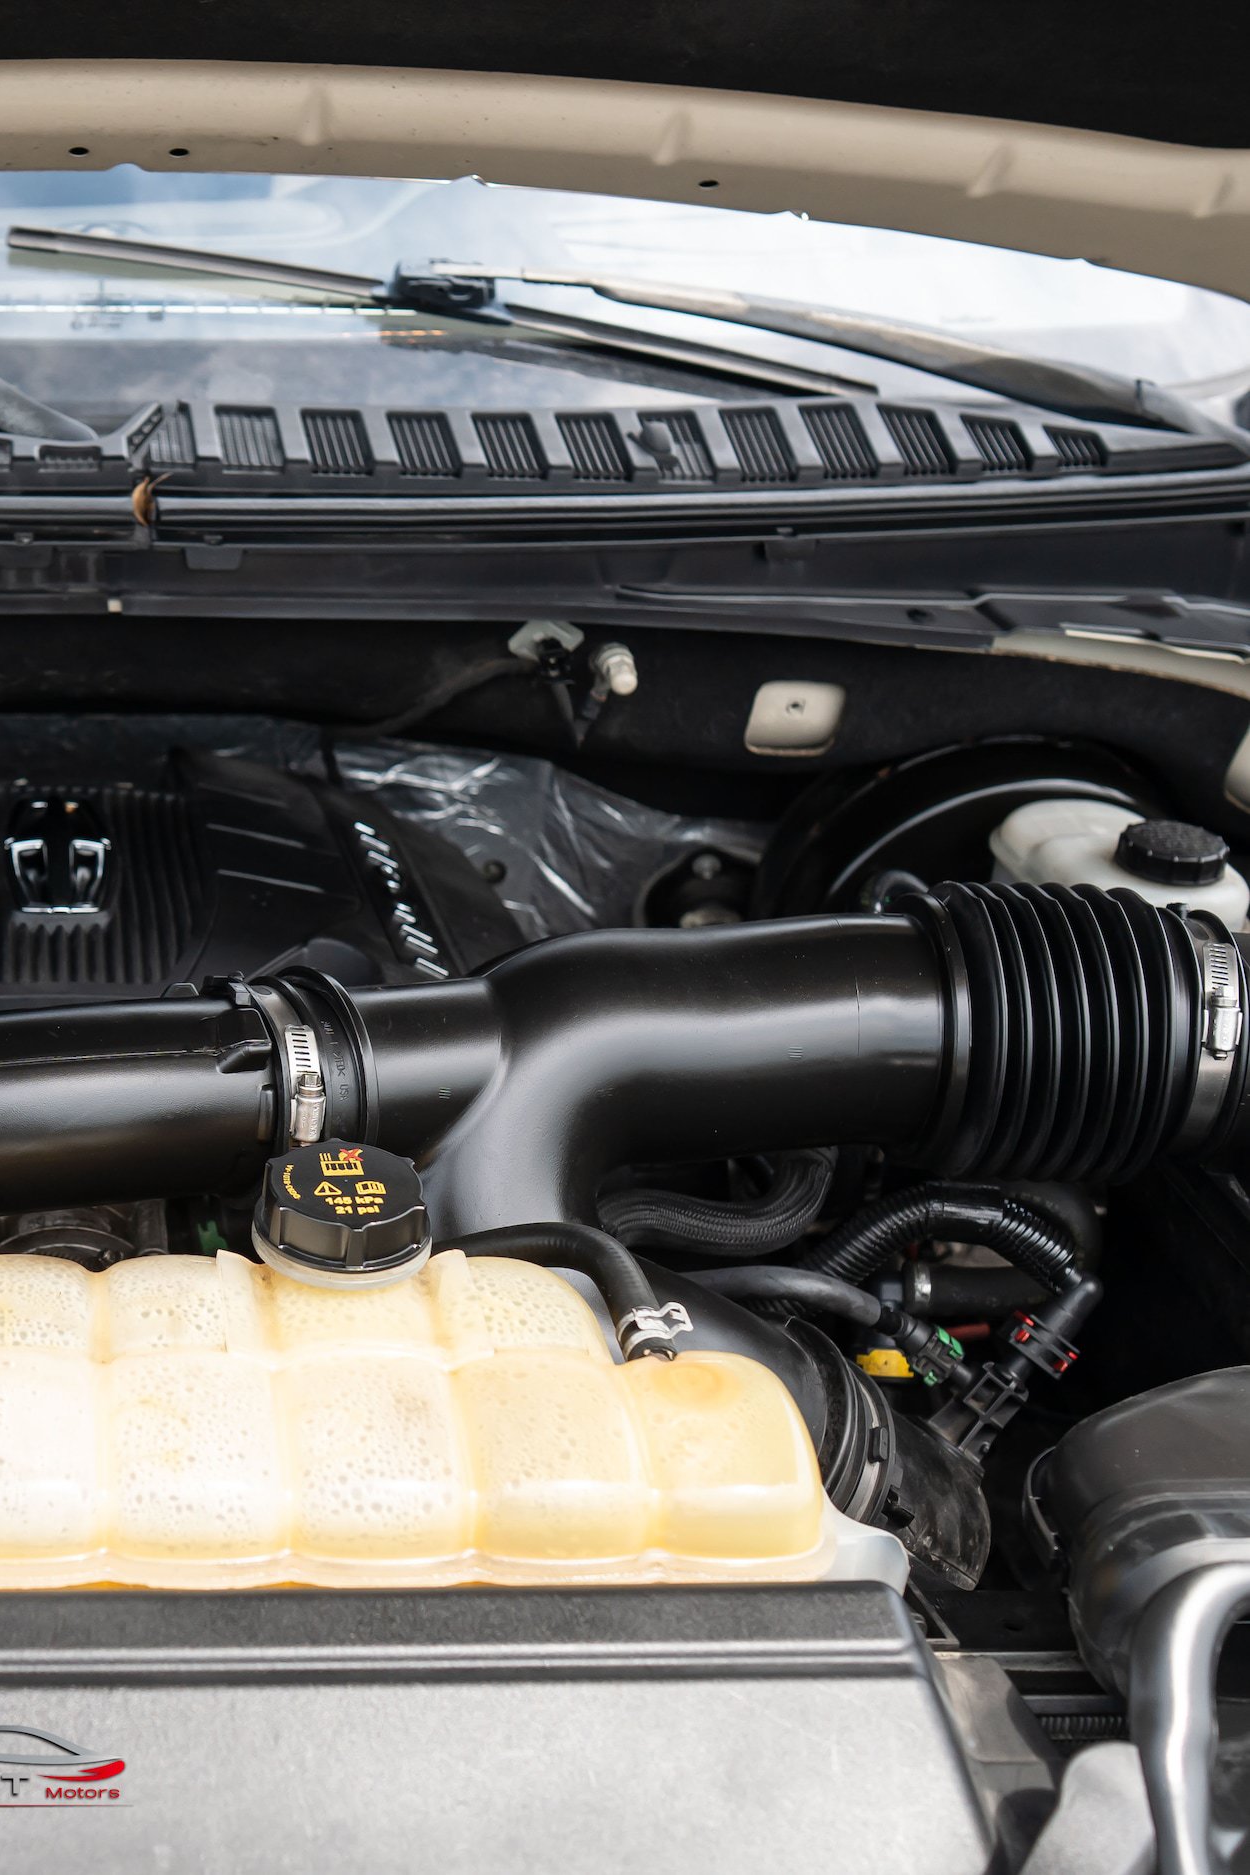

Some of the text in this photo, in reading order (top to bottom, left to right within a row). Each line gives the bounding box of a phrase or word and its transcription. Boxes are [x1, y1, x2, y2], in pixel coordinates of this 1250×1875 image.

[325, 1196, 384, 1206] 145 kPa
[335, 1205, 380, 1215] 21 psi
